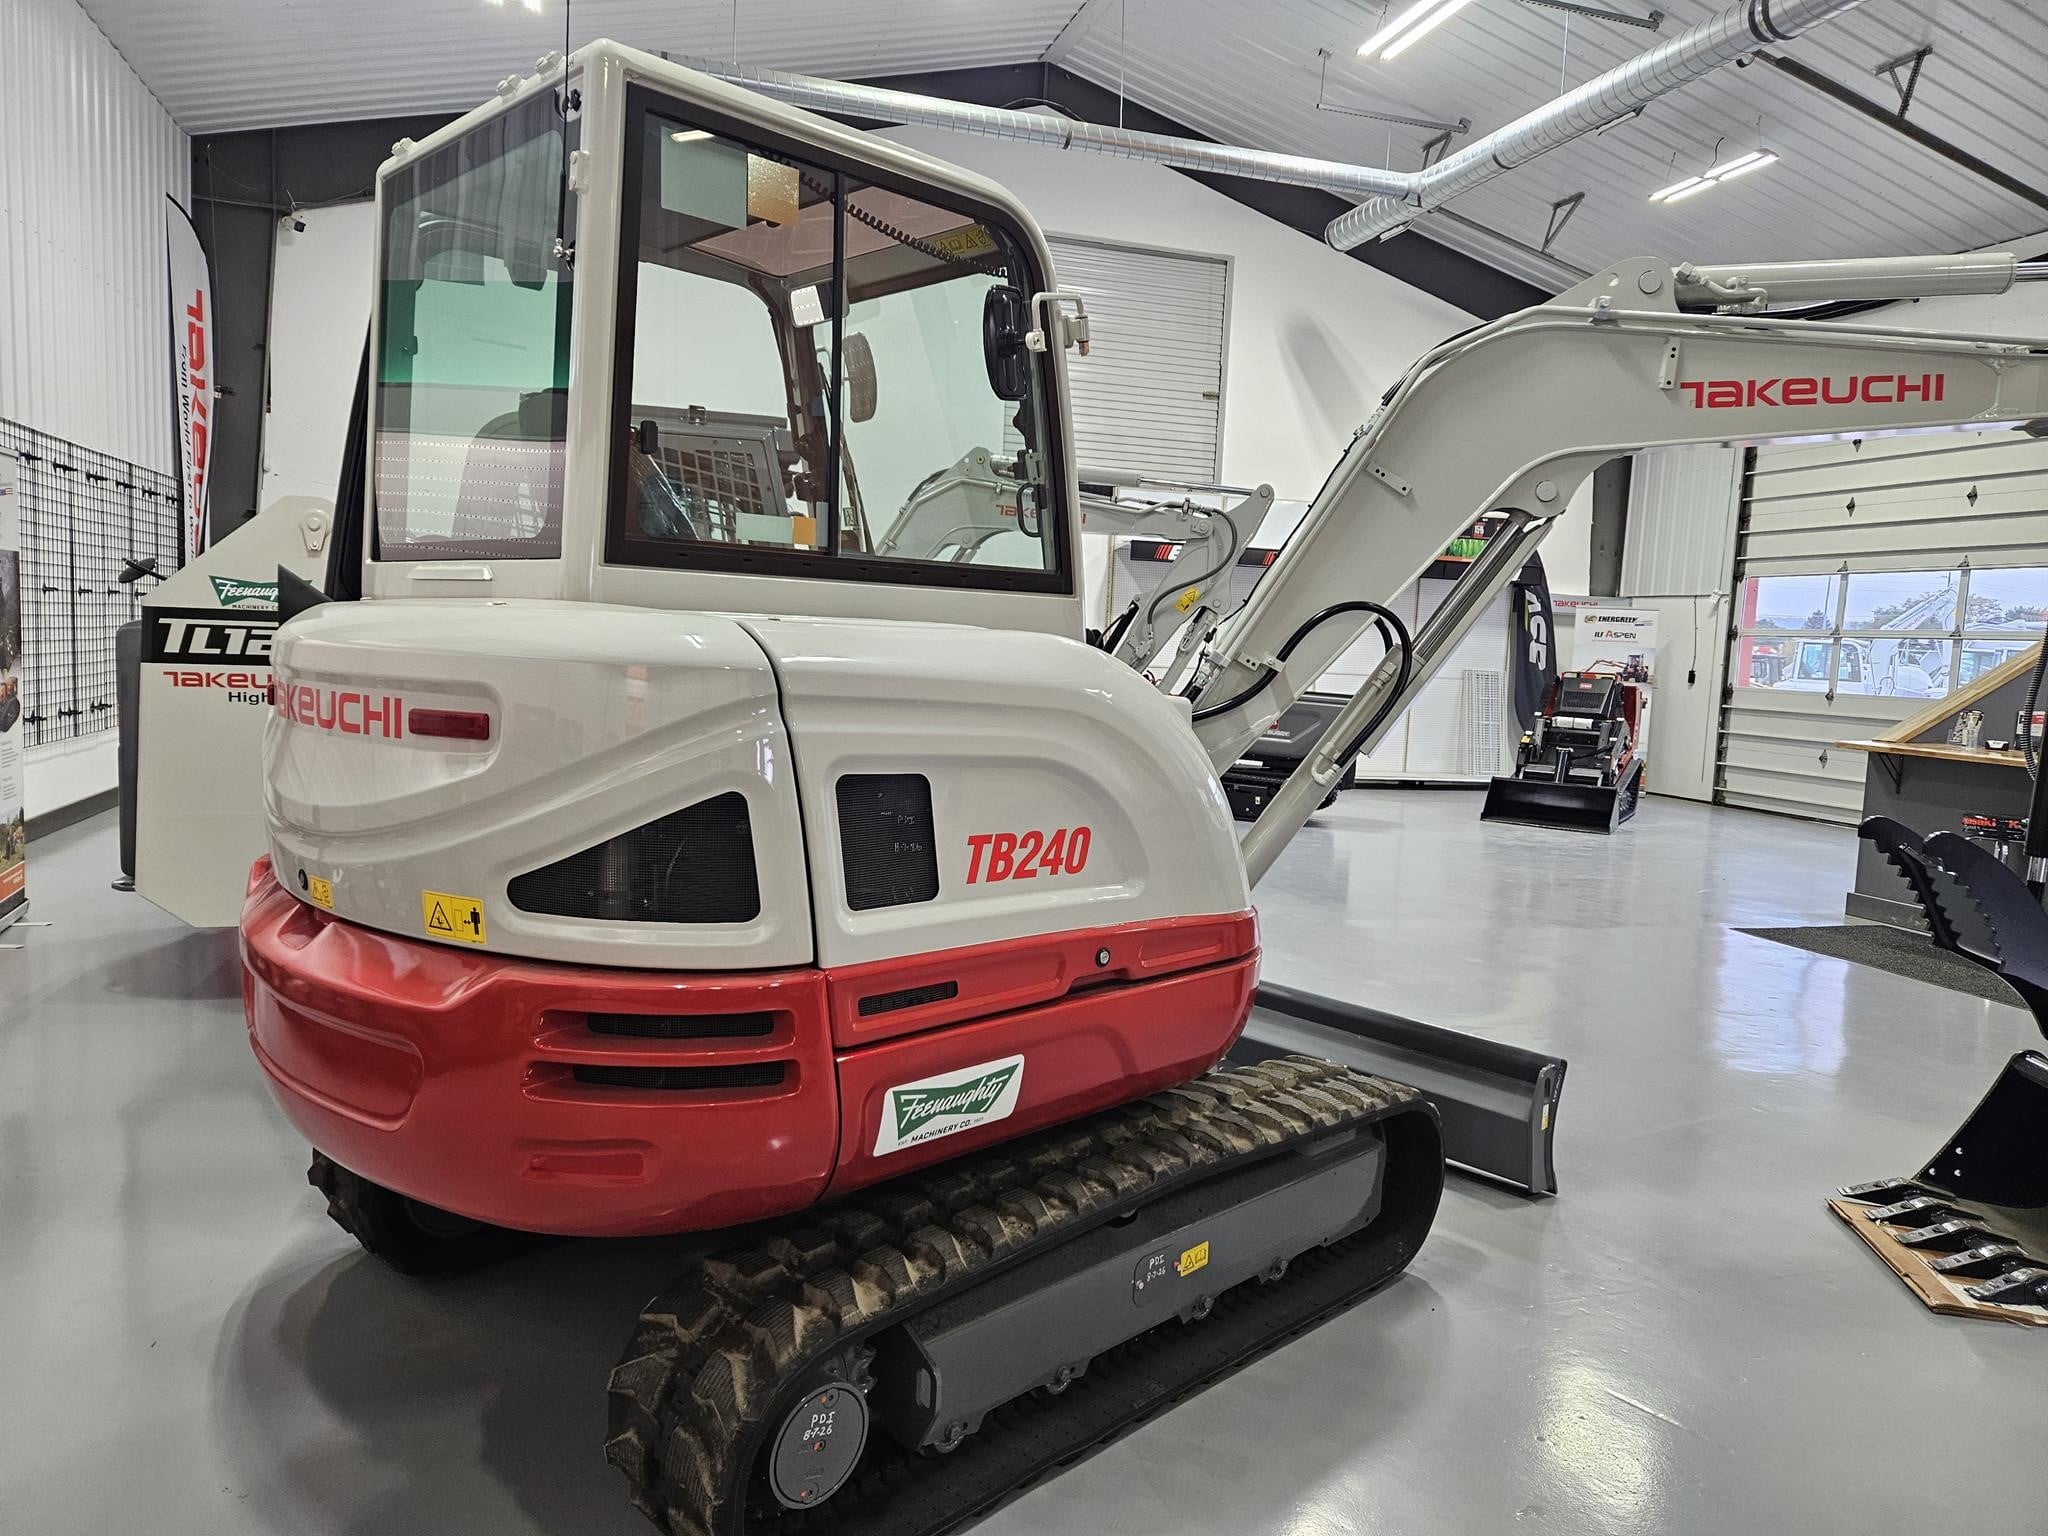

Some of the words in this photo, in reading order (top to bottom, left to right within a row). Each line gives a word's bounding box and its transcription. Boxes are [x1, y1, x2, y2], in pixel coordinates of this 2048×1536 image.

[1680, 373, 1944, 409] TAKEUCHI
[182, 394, 191, 446] World
[187, 289, 207, 558] TAKEU
[1605, 630, 1637, 639] ASPEN
[276, 682, 402, 739] AKEUCHI
[966, 826, 1092, 884] TB240
[900, 1074, 1009, 1130] Feenaughty
[911, 1123, 959, 1143] MACHINERY
[959, 1119, 972, 1129] CO.
[1149, 1254, 1165, 1270] PDI
[811, 1411, 835, 1428] PDI
